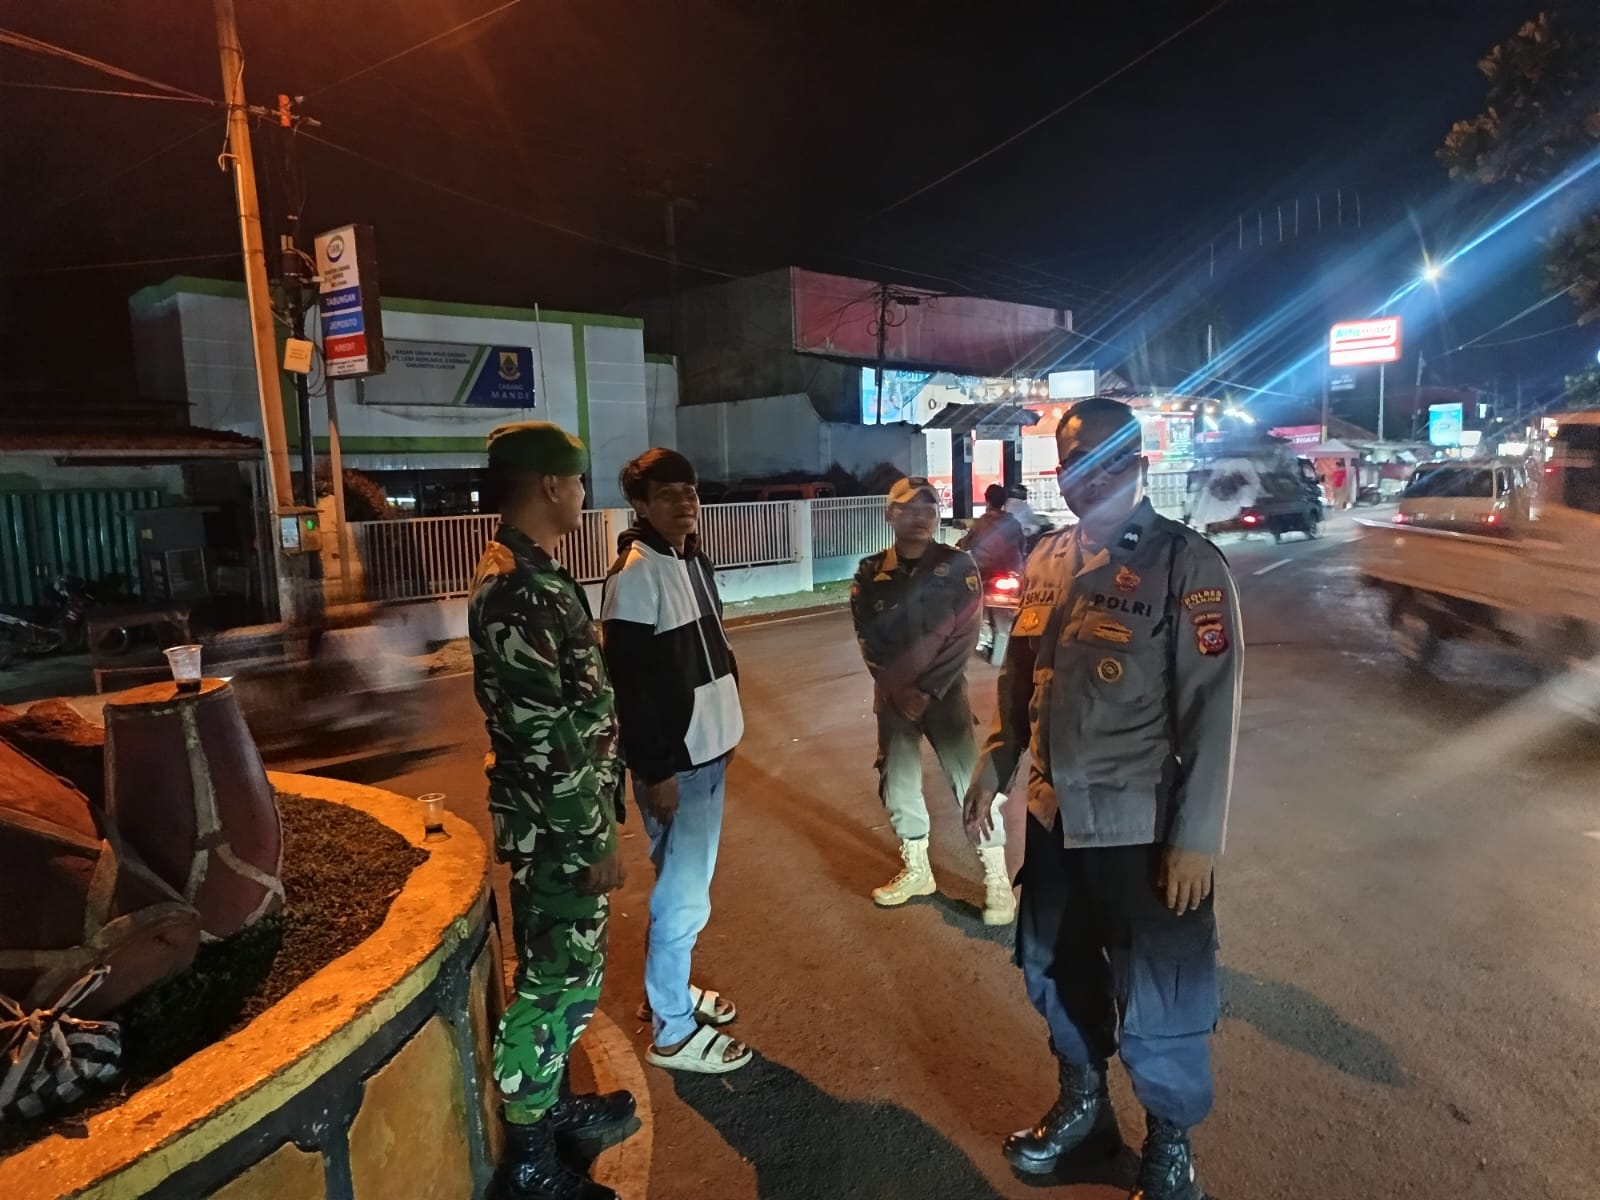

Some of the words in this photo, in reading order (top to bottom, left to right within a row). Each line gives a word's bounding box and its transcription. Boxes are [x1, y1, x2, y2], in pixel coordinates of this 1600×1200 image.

[326, 293, 356, 306] TABUNGAN
[334, 342, 355, 353] KREDIT
[1095, 593, 1152, 617] POLRI
